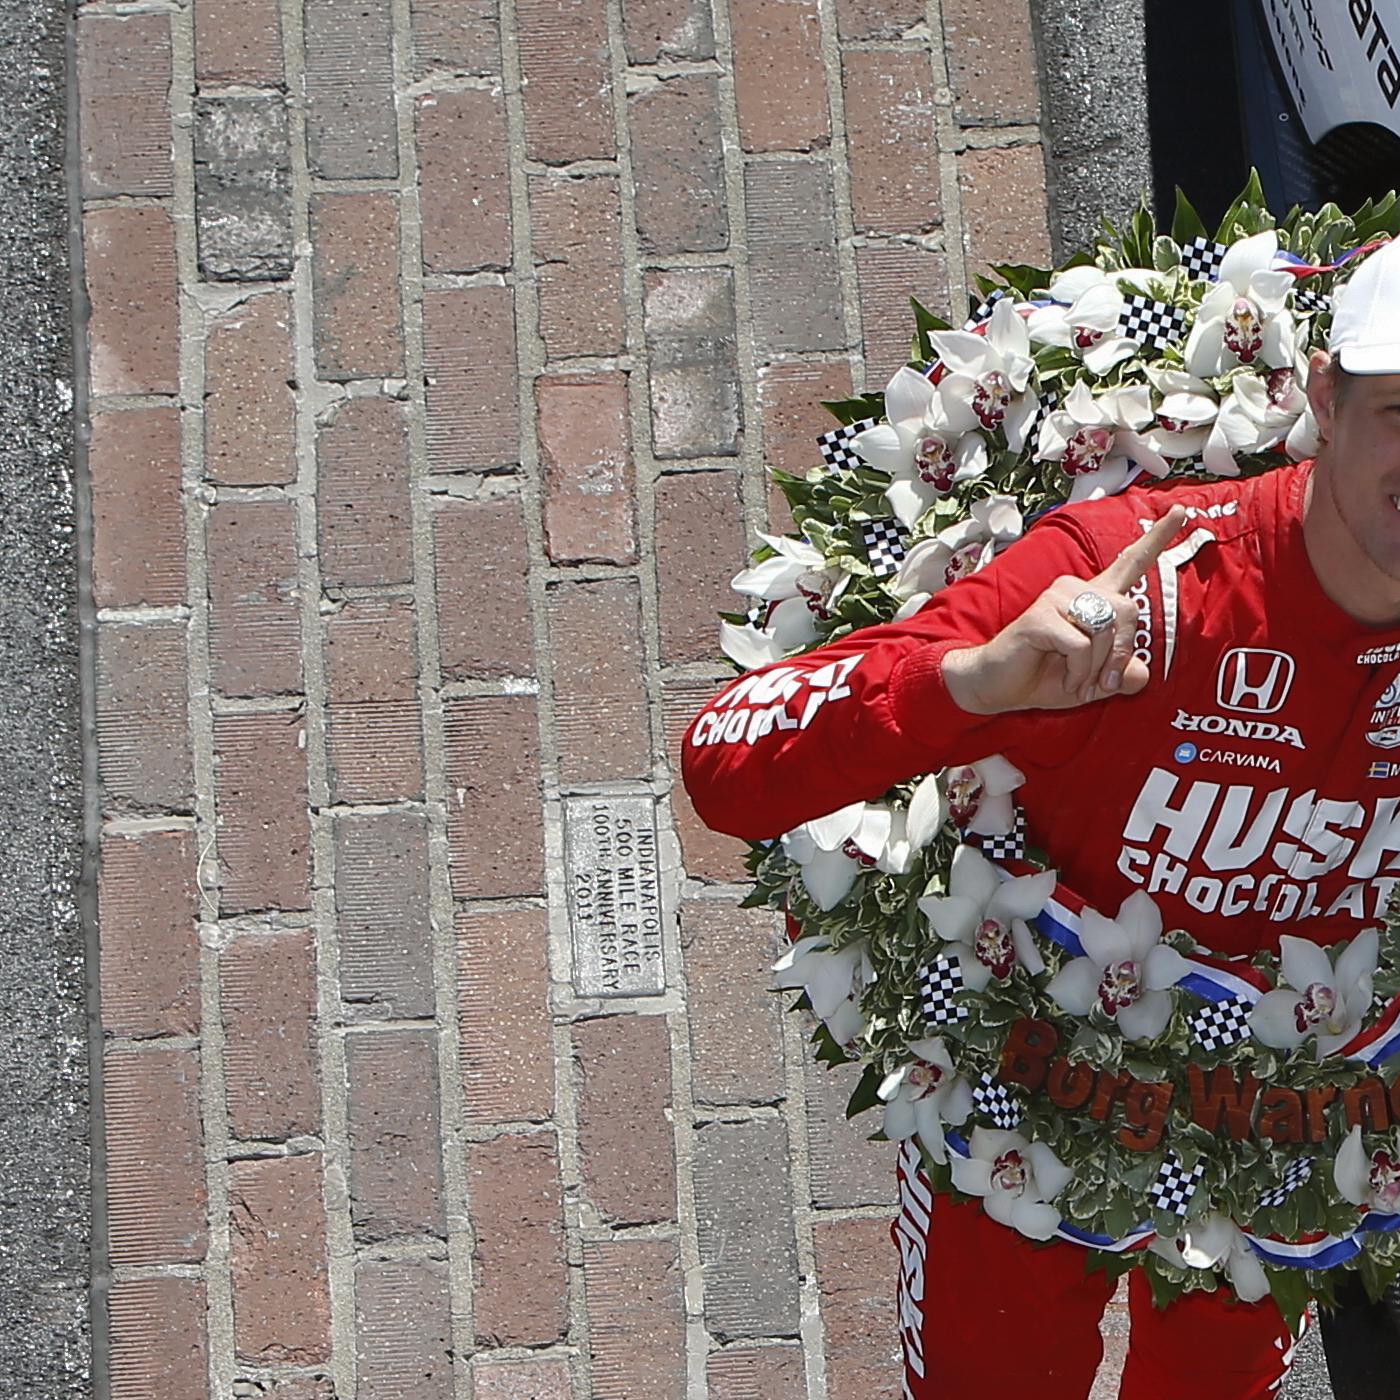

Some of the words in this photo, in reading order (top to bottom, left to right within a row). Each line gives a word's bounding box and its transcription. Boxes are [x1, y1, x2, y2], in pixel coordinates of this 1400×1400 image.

[1170, 709, 1306, 750] HONDA
[1199, 748, 1282, 774] CARVANA
[592, 804, 612, 858] 100TH
[615, 818, 634, 858] 500
[574, 873, 595, 922] 2011
[617, 867, 638, 913] MILE
[636, 827, 661, 962] INDIANAPOLIS
[596, 866, 620, 991] ANNIVERSARY
[620, 923, 641, 975] RACE
[1000, 1017, 1174, 1152] Borg
